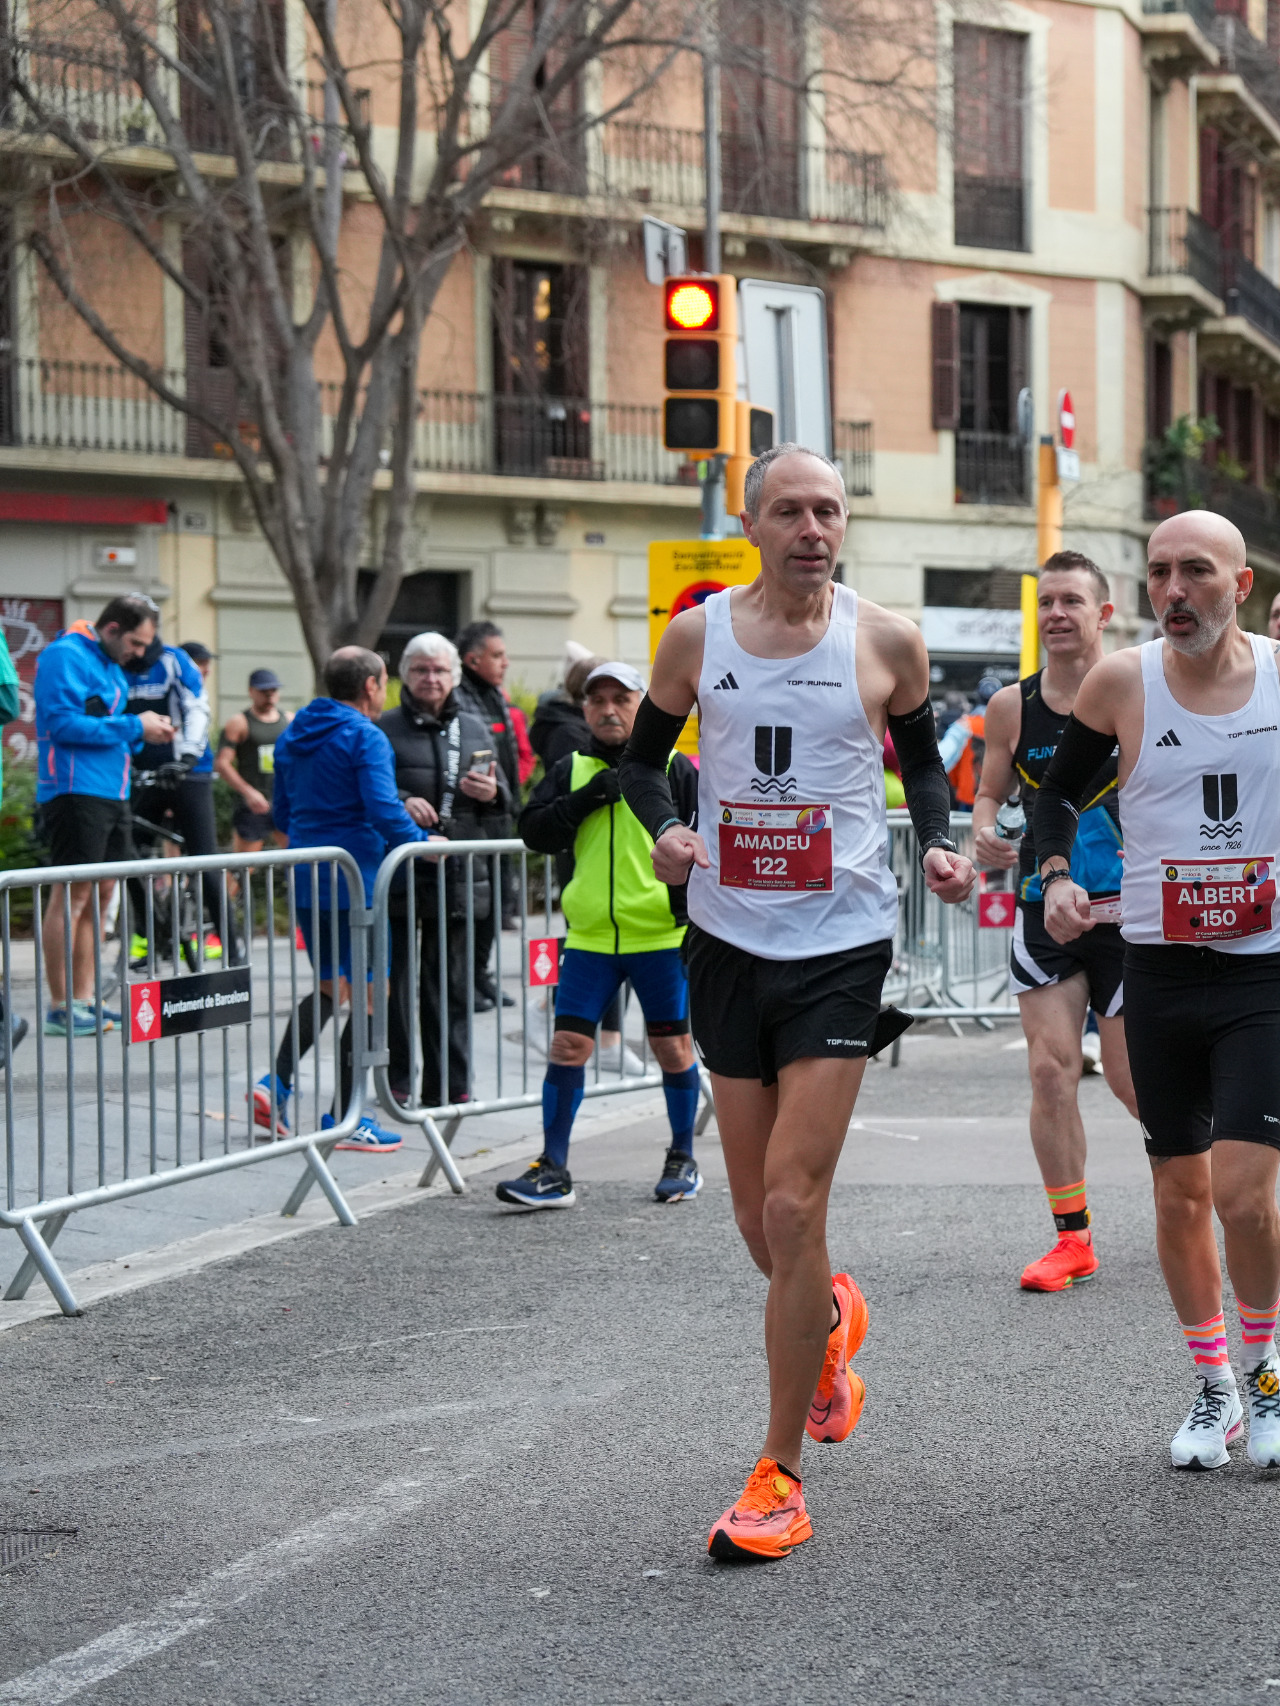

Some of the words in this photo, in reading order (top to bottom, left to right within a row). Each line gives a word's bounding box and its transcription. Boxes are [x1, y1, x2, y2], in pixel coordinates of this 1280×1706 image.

[733, 833, 810, 850] AMADEU
[1225, 841, 1242, 850] 1926
[752, 857, 788, 875] 122
[1178, 886, 1258, 905] ALBERT
[1200, 909, 1237, 927] 150
[162, 997, 204, 1018] Ajuntament
[205, 994, 214, 1008] de
[214, 990, 249, 1007] Barcelona
